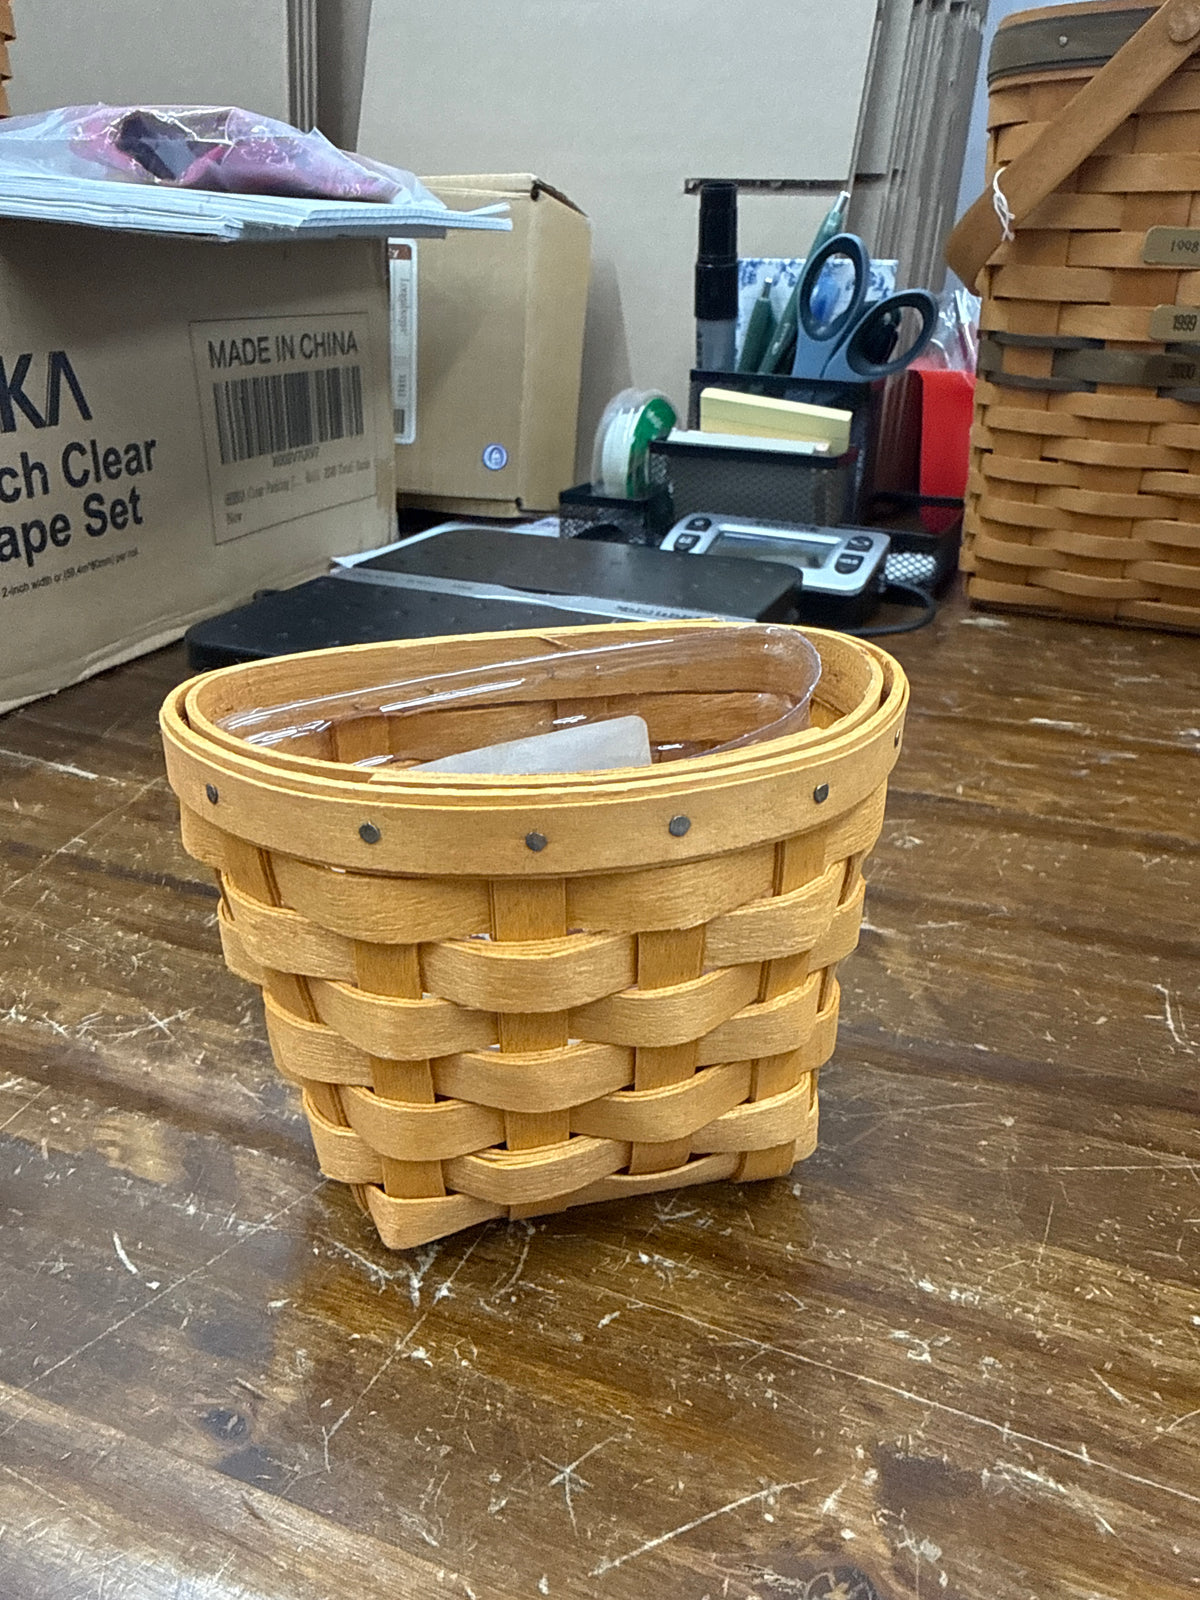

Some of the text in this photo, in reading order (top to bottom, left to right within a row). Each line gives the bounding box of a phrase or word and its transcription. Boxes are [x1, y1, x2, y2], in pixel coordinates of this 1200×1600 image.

[1171, 240, 1200, 253] 1998
[1173, 314, 1197, 331] 1999
[208, 330, 358, 368] MADE IN CHINA
[61, 439, 157, 488] Clear
[0, 486, 143, 568] ape Set
[2, 582, 29, 598] 2-inch
